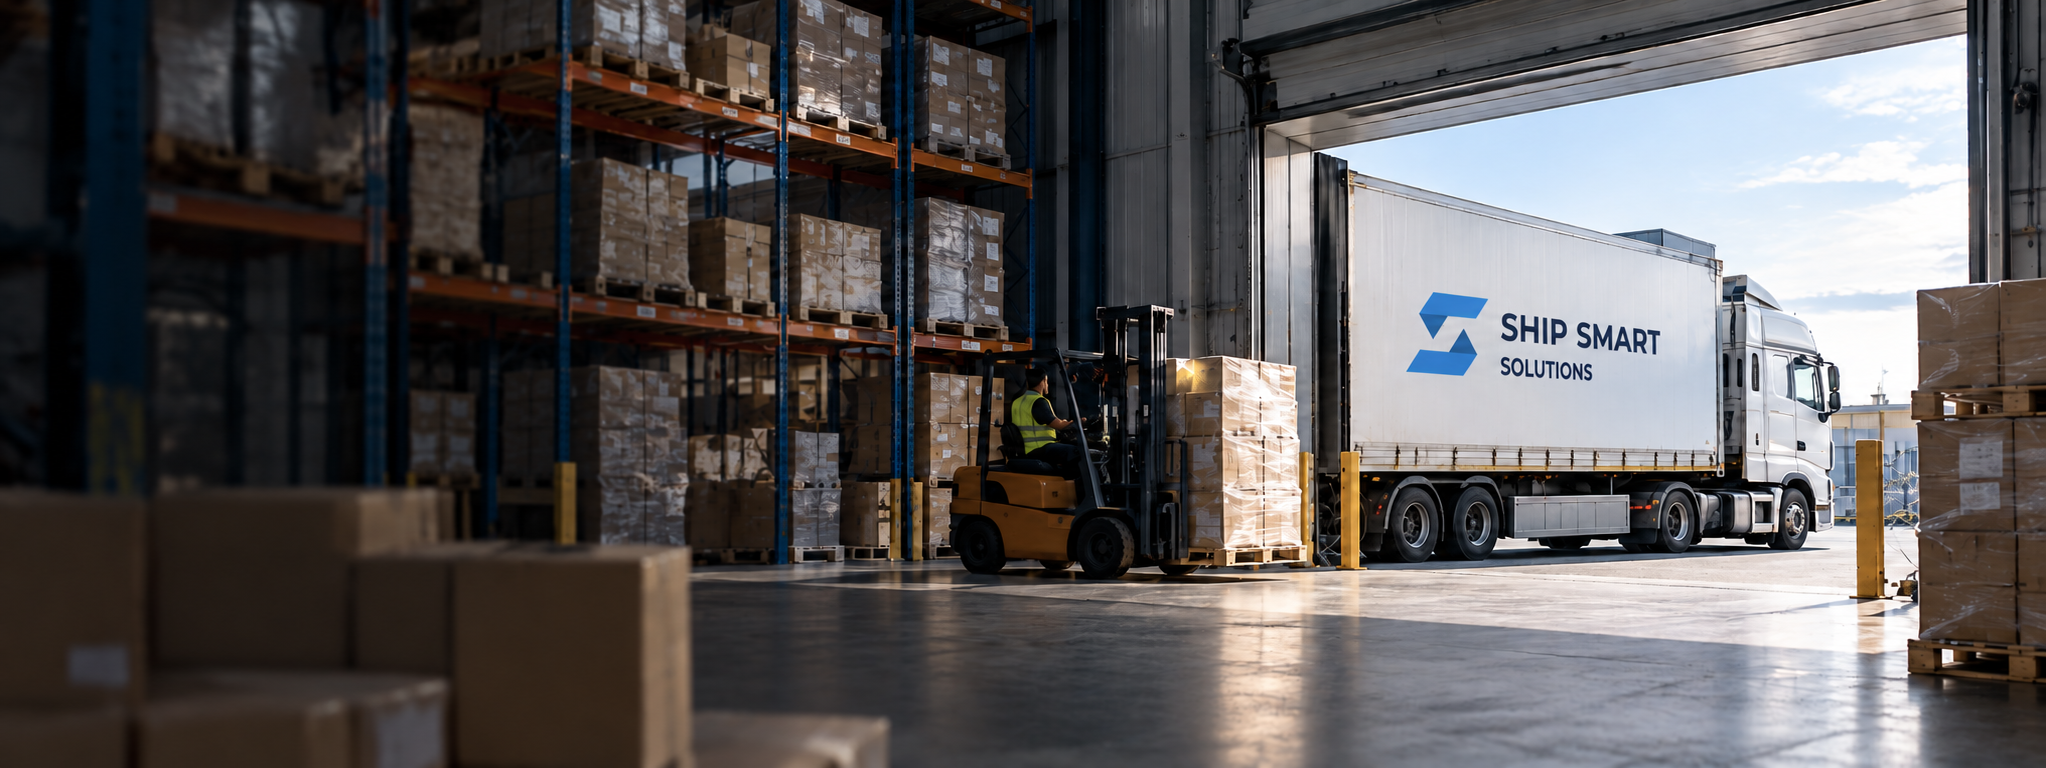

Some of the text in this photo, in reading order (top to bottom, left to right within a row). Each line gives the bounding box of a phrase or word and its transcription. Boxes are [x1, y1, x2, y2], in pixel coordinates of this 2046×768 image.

[1501, 312, 1661, 355] SHIP SMART
[1500, 356, 1593, 381] SOLUTIONS
